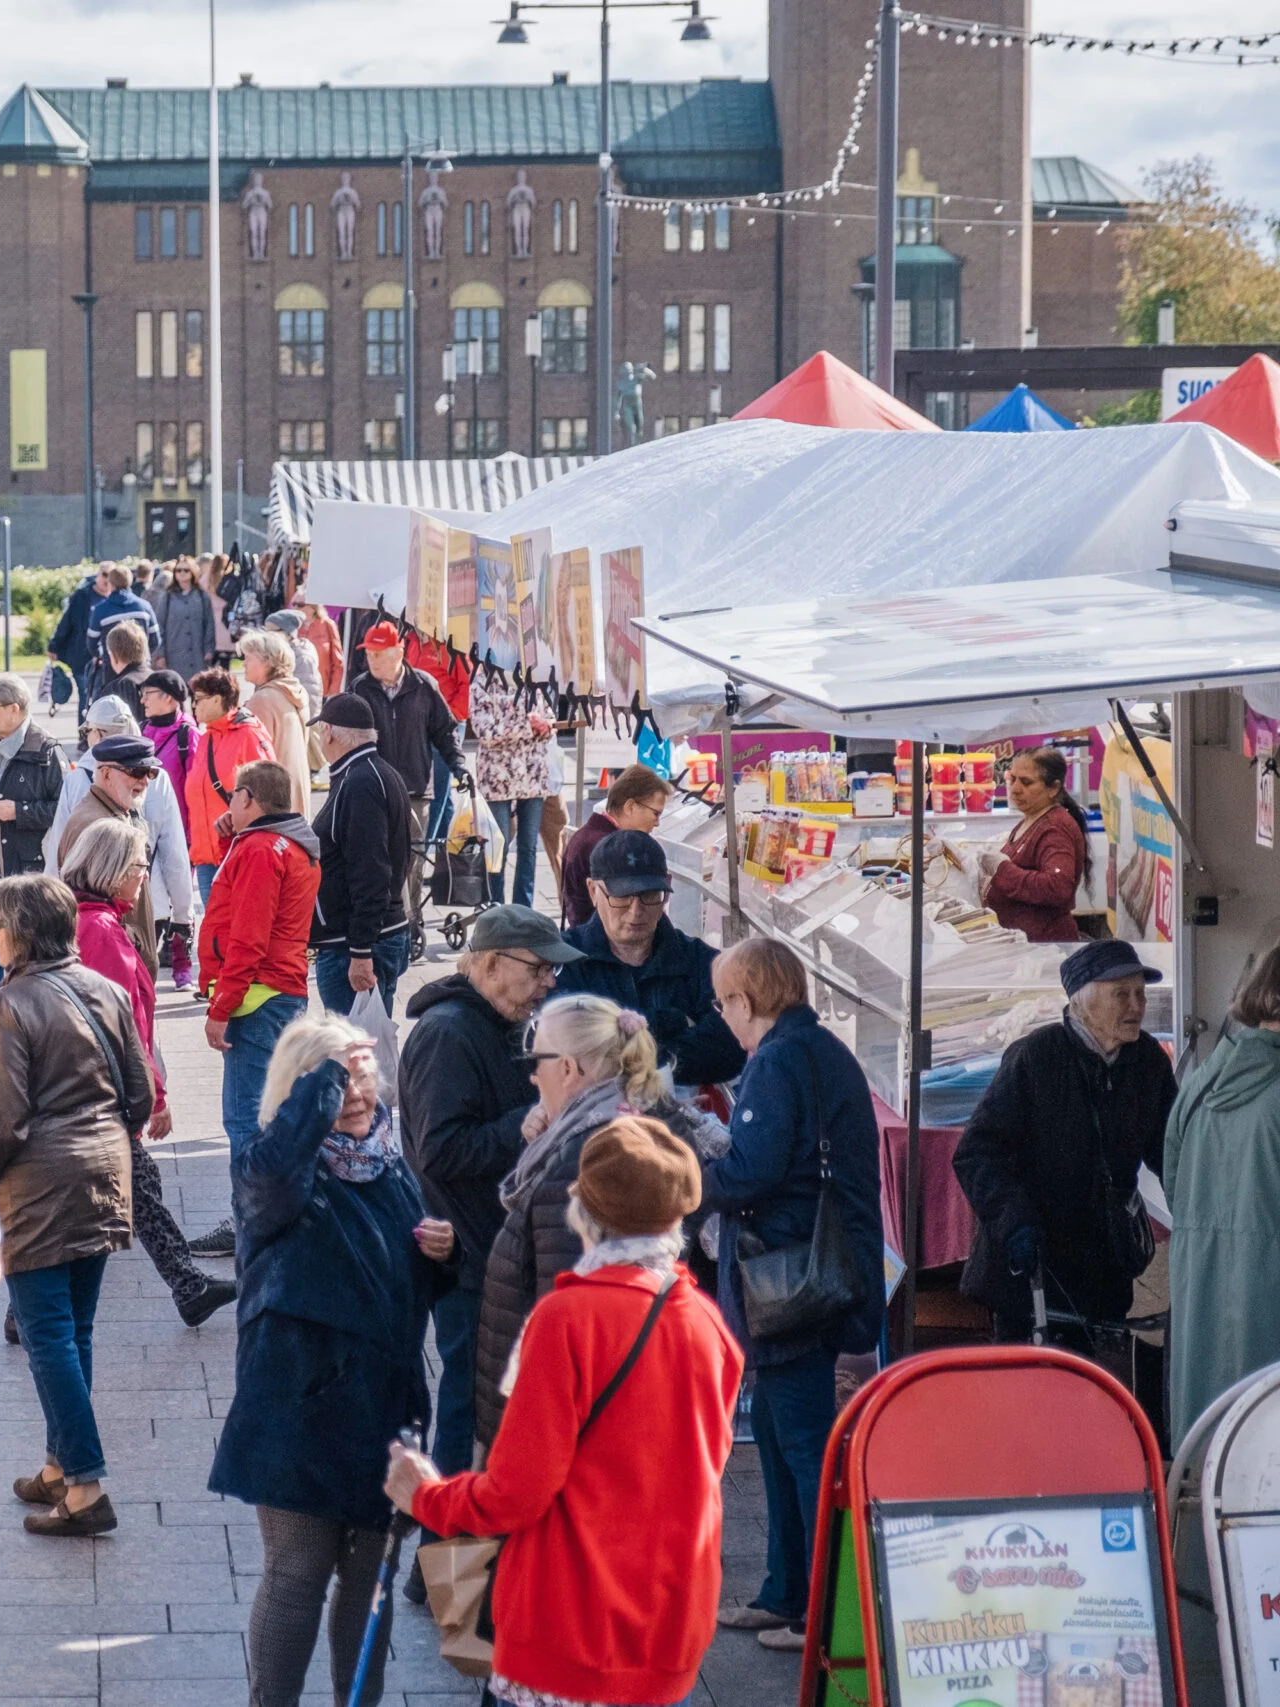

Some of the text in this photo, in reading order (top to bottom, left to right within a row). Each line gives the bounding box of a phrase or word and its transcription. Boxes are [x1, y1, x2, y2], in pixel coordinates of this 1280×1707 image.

[964, 1541, 1068, 1560] KIVIKYLÄN
[903, 1611, 1027, 1646] Kunkku
[907, 1638, 1030, 1678] KINKKU
[947, 1676, 992, 1691] PIZZA
